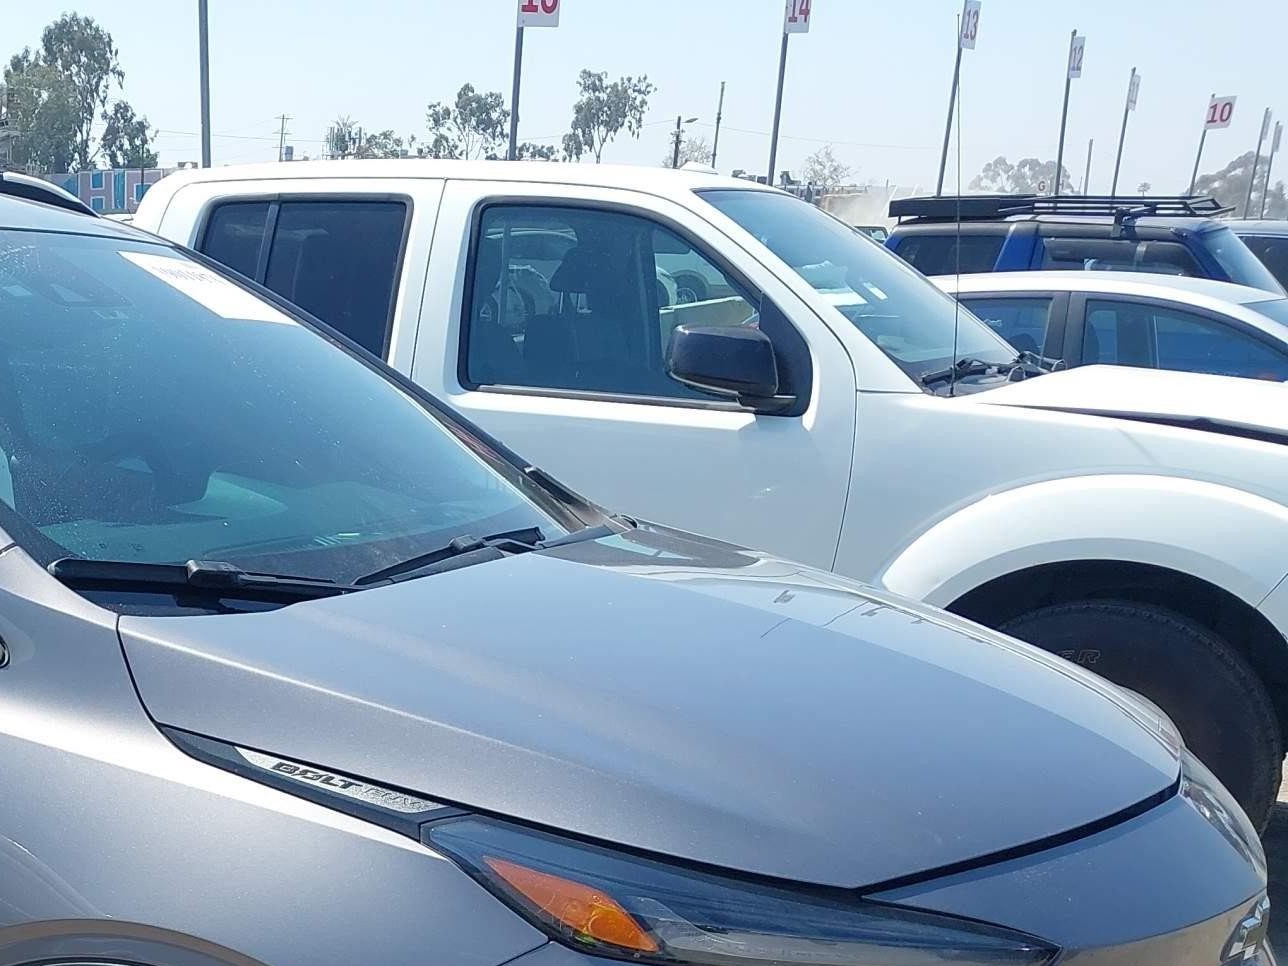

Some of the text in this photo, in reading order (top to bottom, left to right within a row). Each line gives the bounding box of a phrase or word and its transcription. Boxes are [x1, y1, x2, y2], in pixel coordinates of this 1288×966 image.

[964, 9, 979, 40] 13
[1072, 45, 1084, 71] 12
[1206, 102, 1233, 124] 10
[271, 761, 363, 790] BOLT
